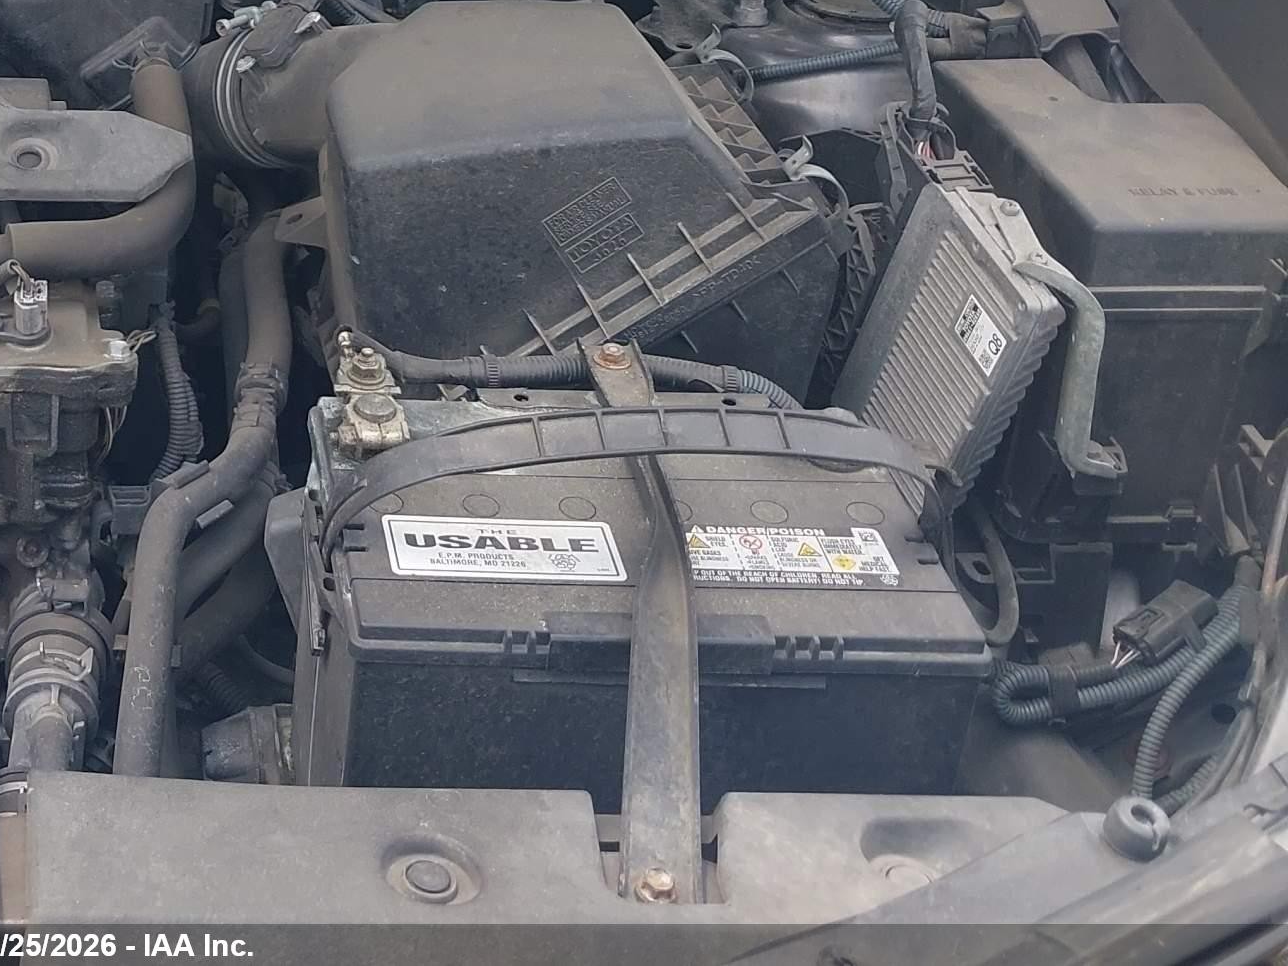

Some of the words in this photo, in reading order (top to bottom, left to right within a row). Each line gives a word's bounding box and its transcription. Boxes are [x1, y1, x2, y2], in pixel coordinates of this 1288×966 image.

[1128, 187, 1177, 196] RELAY
[571, 217, 634, 258] TOYOTA
[988, 333, 1003, 355] Q8
[705, 526, 825, 535] DANGER/POISON
[404, 533, 600, 553] USABLE
[438, 552, 465, 560] E.P.M.
[468, 552, 514, 560] PRODUCTS
[430, 558, 482, 567] BALTIMORE,
